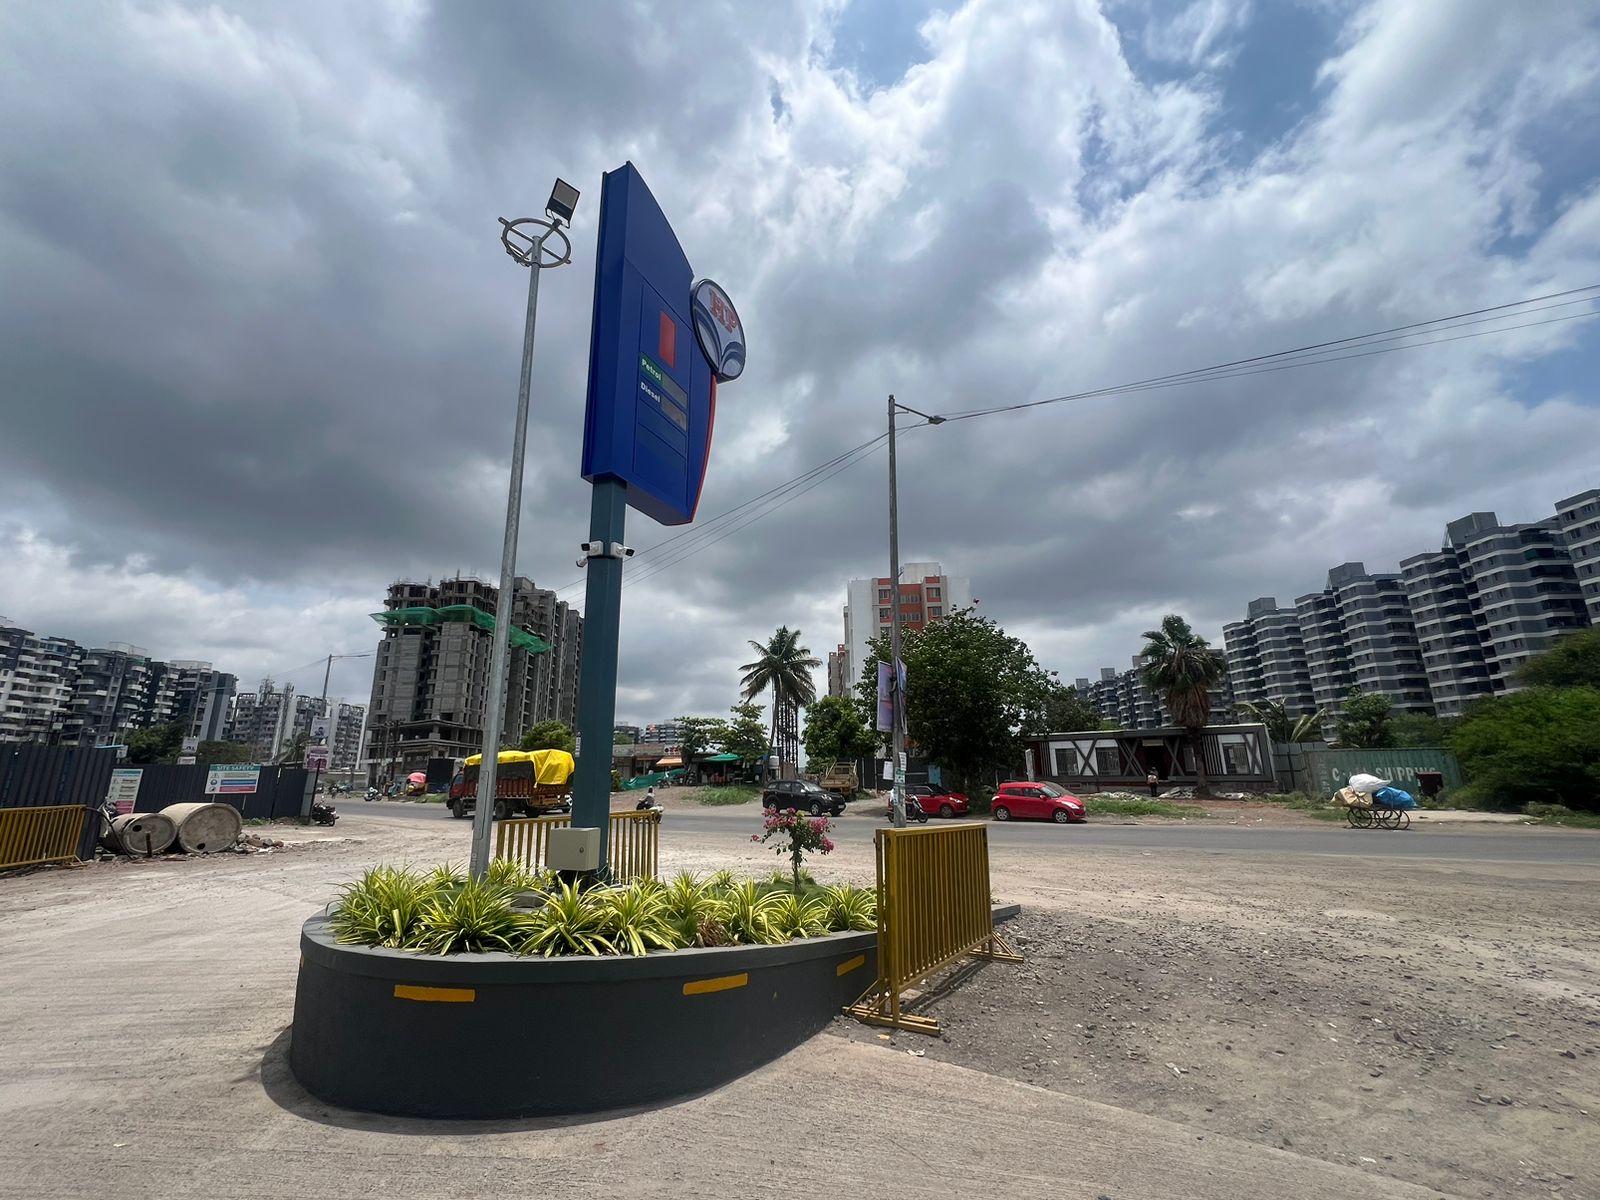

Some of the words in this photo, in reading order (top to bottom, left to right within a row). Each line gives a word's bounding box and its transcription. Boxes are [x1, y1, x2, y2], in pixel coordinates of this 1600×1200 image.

[709, 287, 739, 333] HP
[641, 358, 662, 381] Petrol
[640, 381, 661, 403] Diesel
[1375, 767, 1436, 783] SHIPP
